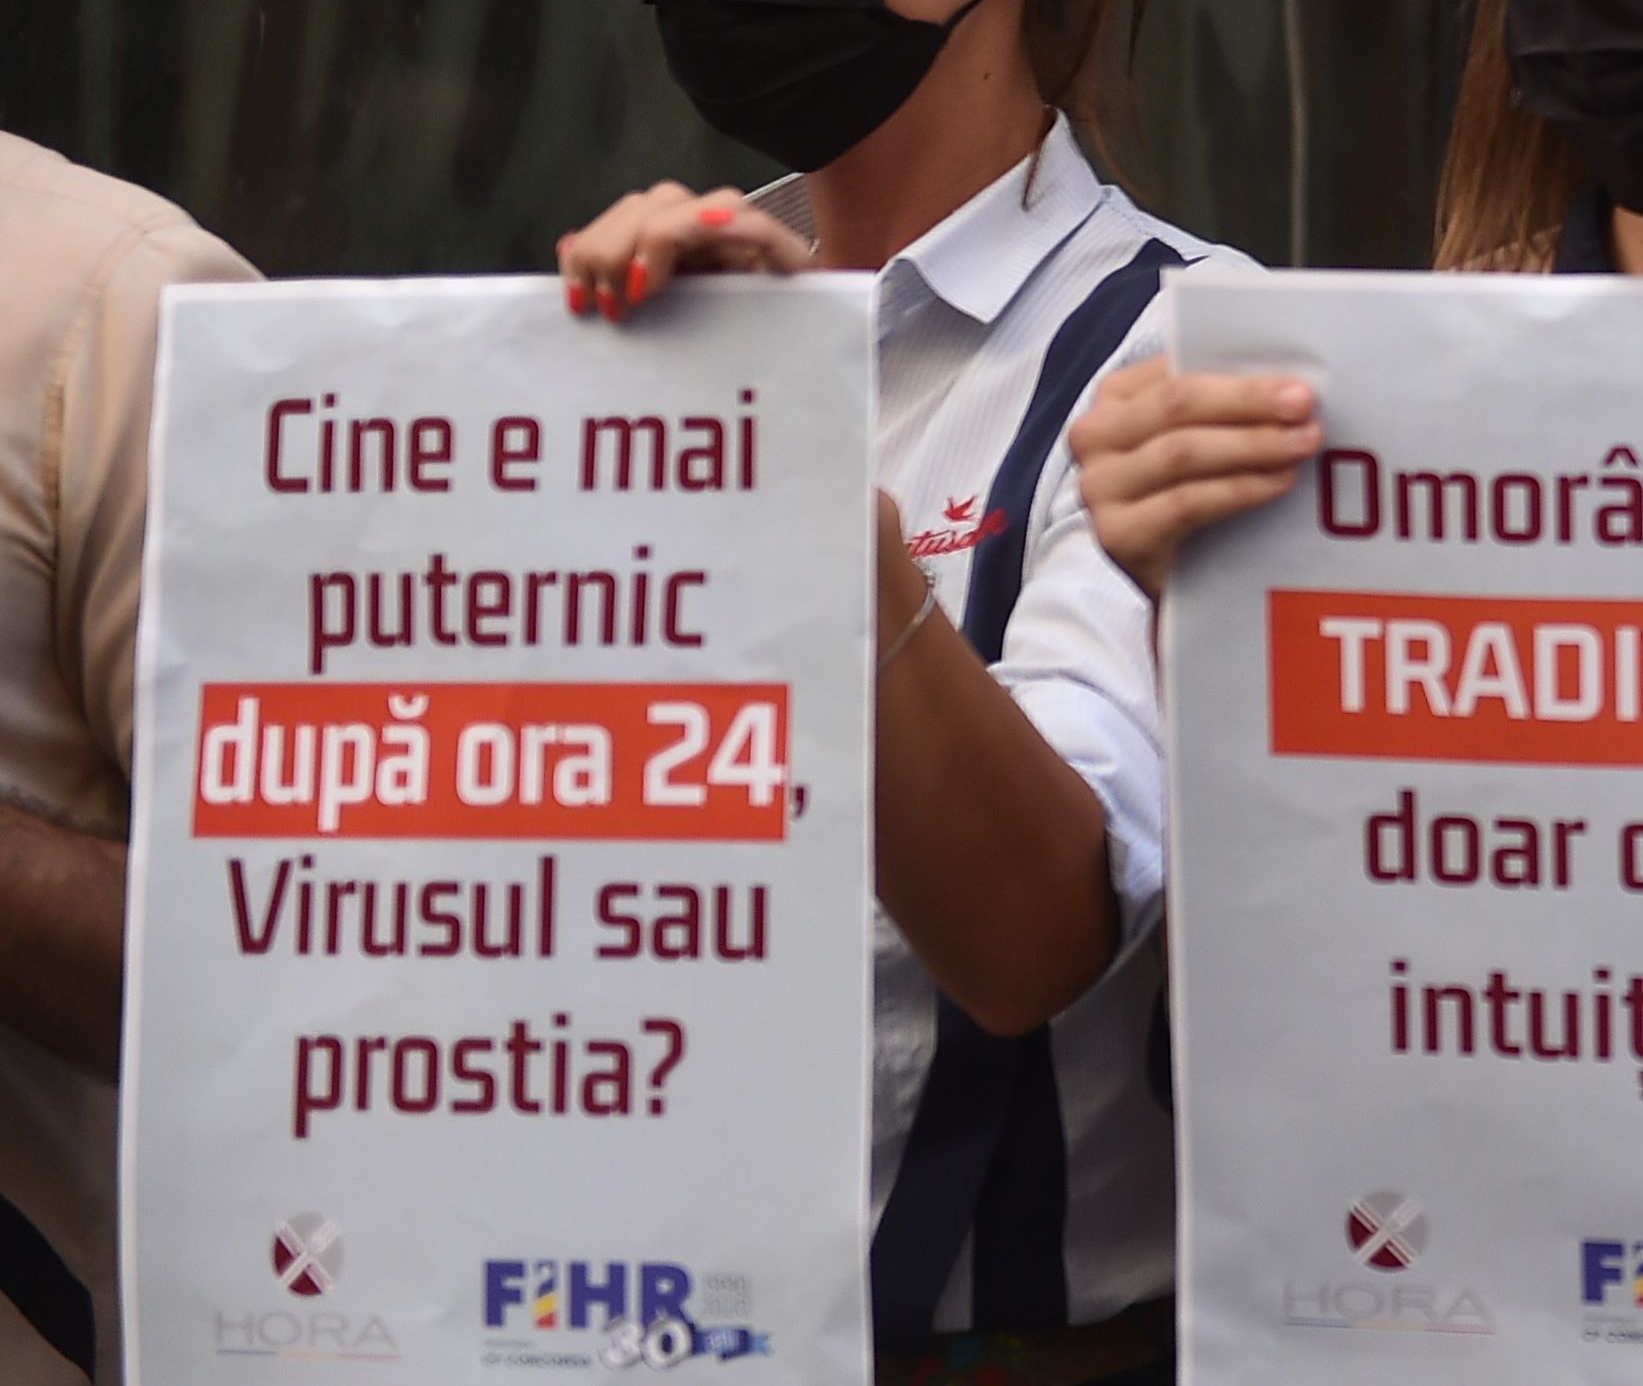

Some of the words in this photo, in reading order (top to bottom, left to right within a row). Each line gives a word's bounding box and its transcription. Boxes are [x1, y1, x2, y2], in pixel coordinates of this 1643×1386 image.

[265, 394, 452, 493] Cine
[489, 415, 542, 493] e
[578, 389, 756, 492] mai
[308, 545, 707, 674] puternic
[200, 695, 432, 832] după
[456, 721, 613, 806] ora
[1365, 789, 1587, 888] doar
[226, 854, 559, 959] Virusul
[594, 882, 769, 962] sau
[293, 1012, 686, 1138] prostia?
[215, 1311, 397, 1348] HORA
[1282, 1281, 1491, 1323] HORA
